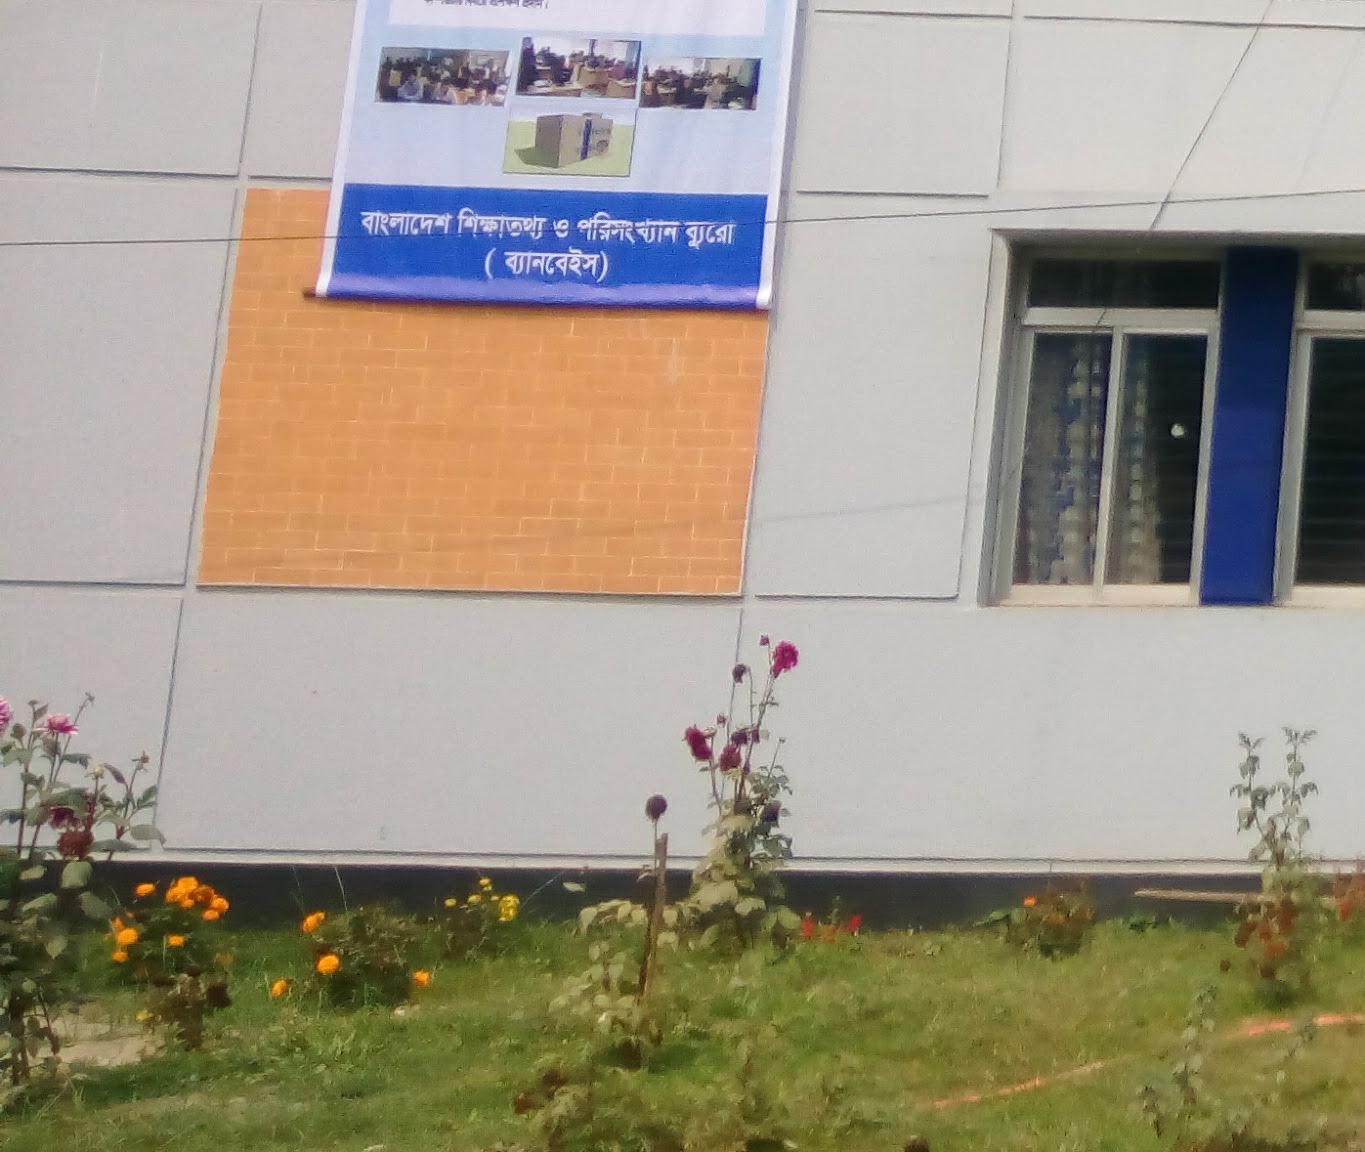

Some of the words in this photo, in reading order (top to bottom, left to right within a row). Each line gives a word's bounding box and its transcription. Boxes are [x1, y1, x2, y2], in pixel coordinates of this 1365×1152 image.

[361, 211, 450, 237] বাংলাদেশ
[457, 208, 545, 239] শিক্ষাতথ্য
[553, 220, 568, 239] ও
[577, 212, 677, 245] পরিসংখ্যান
[685, 221, 735, 250] ব্যুরো
